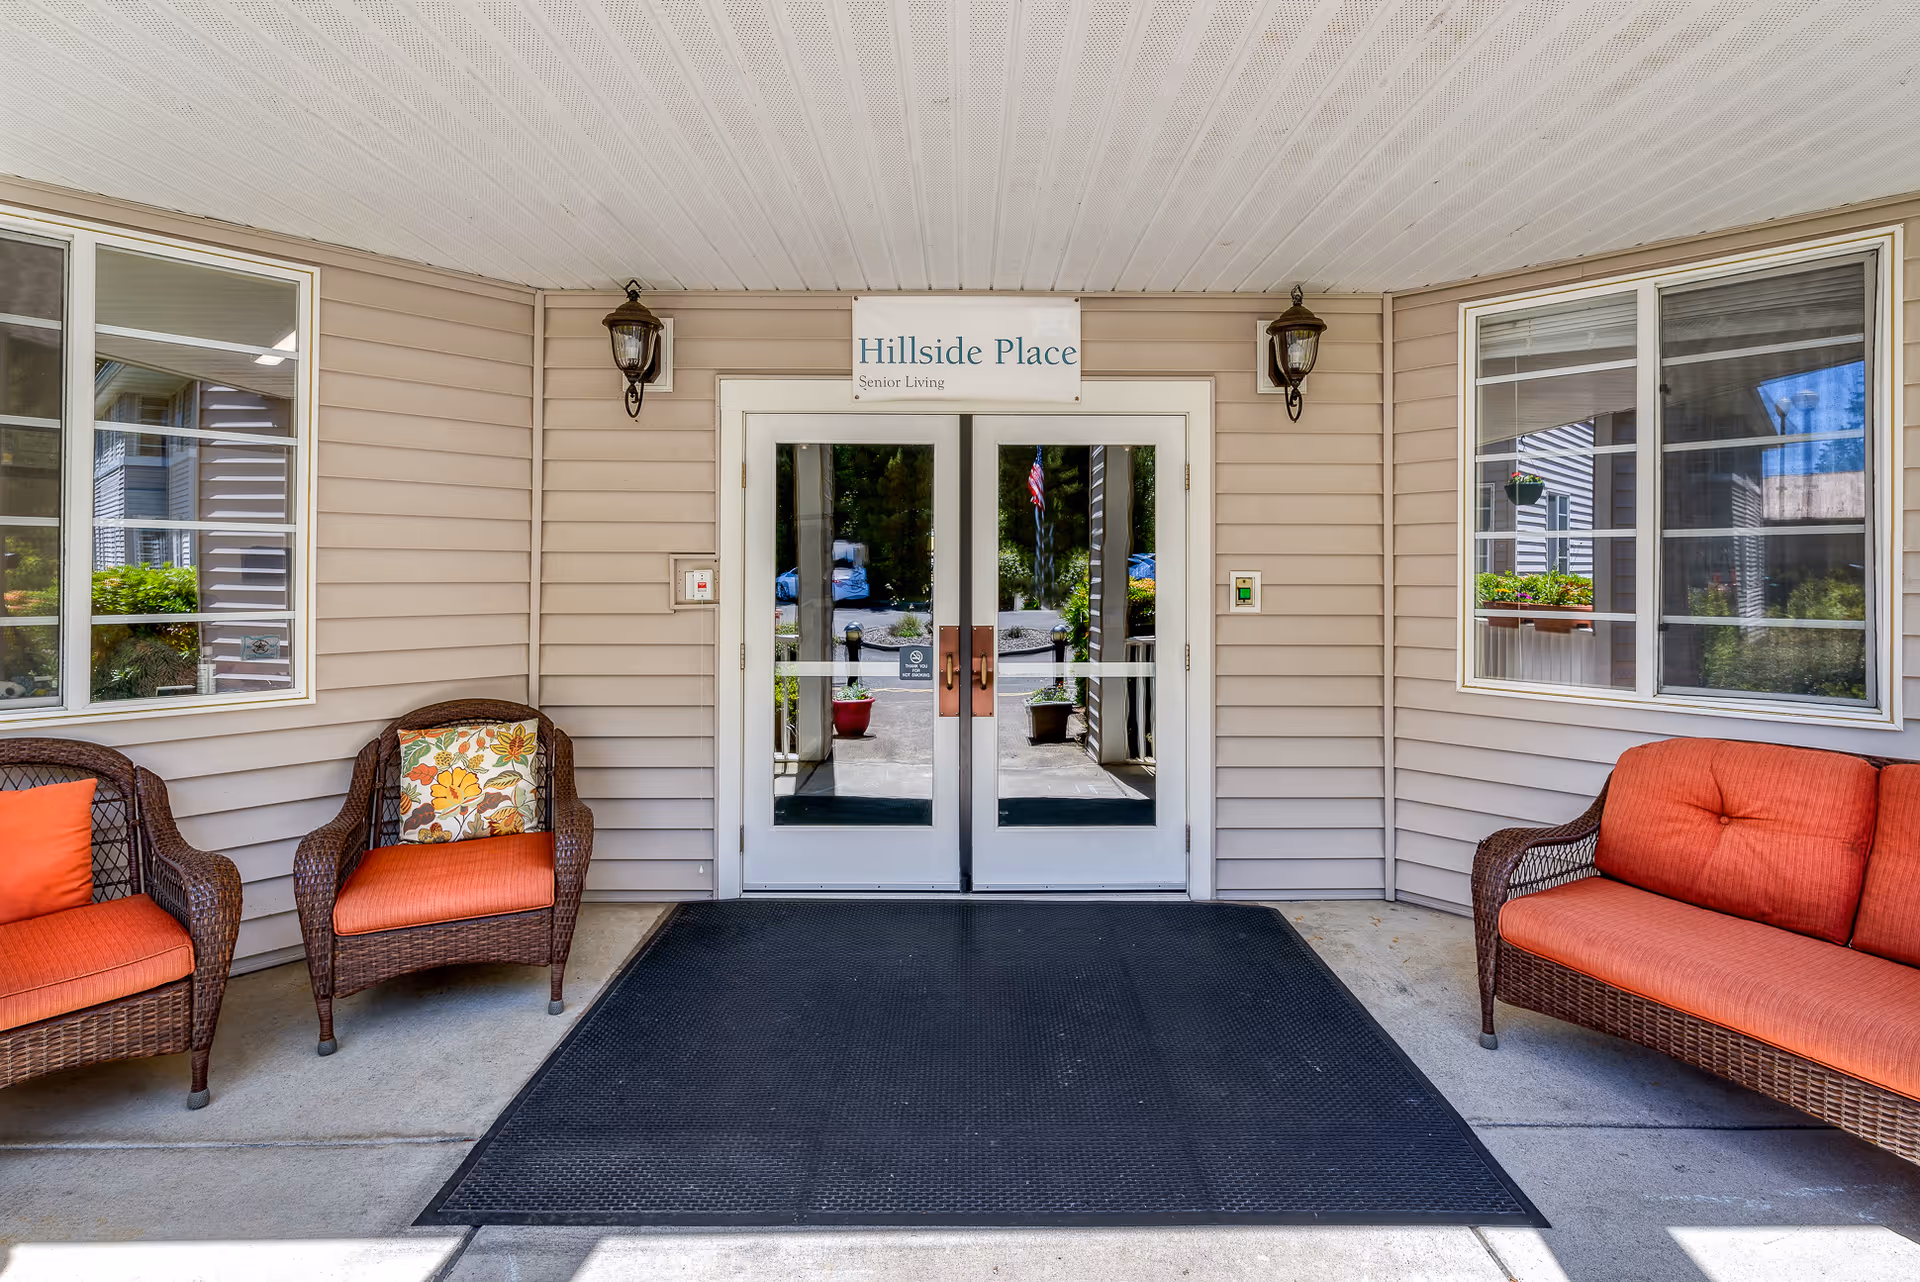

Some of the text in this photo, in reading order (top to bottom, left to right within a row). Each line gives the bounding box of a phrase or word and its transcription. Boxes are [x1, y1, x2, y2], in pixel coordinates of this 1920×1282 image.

[858, 336, 1078, 365] Hillside Place
[858, 374, 945, 391] Senior Living
